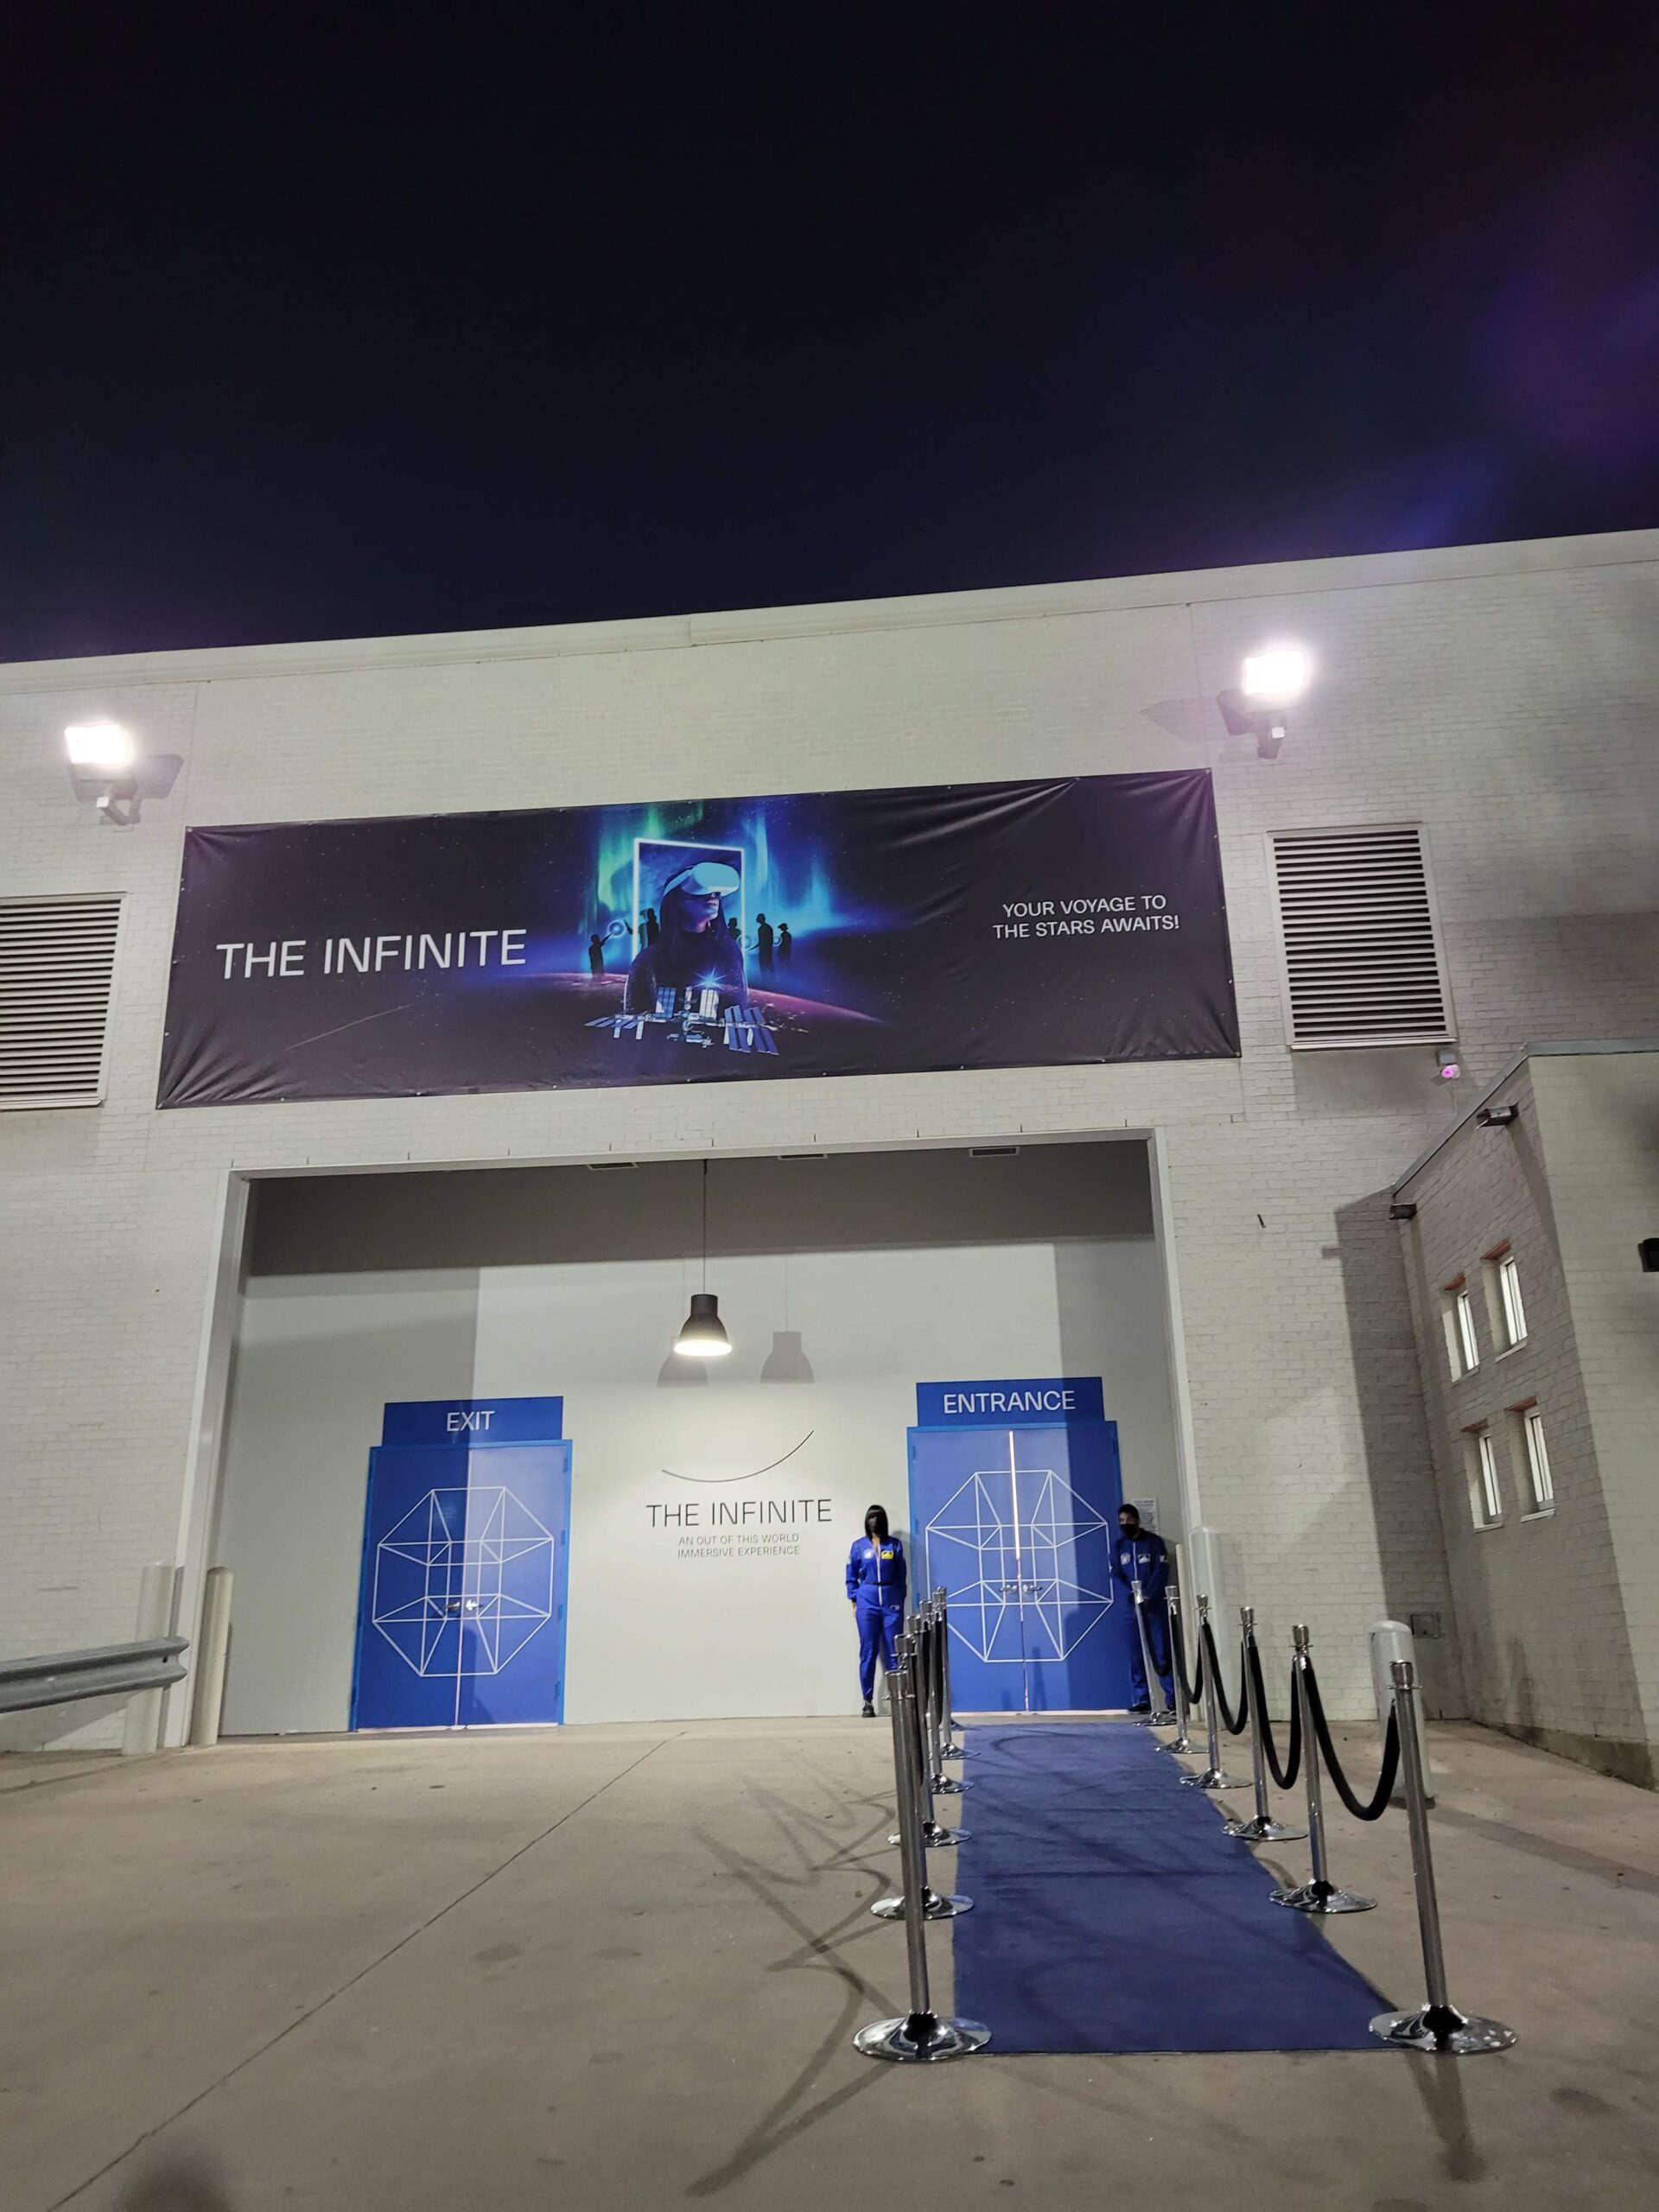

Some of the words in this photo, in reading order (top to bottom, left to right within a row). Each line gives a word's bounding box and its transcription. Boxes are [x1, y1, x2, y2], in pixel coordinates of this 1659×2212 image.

[1002, 901, 1056, 918] YOUR
[1060, 896, 1136, 914] VOYAGE
[1141, 894, 1166, 910] TO
[993, 923, 1031, 939] THE
[1035, 920, 1095, 938] STARS
[1100, 914, 1179, 933] AWAITS!
[216, 939, 307, 979] THE
[323, 928, 527, 974] INFINITE
[944, 1390, 1077, 1414] ENTRANCE
[446, 1410, 496, 1432] EXIT
[645, 1503, 700, 1528] THE
[711, 1498, 833, 1526] INFINITE
[677, 1548, 734, 1558] IMMERSIVE
[738, 1545, 800, 1556] EXPERIENCE
[678, 1535, 694, 1546] AN
[696, 1535, 717, 1545] OUT
[720, 1534, 734, 1545] OF
[737, 1534, 759, 1544] THIS
[761, 1533, 800, 1543] WORLD
